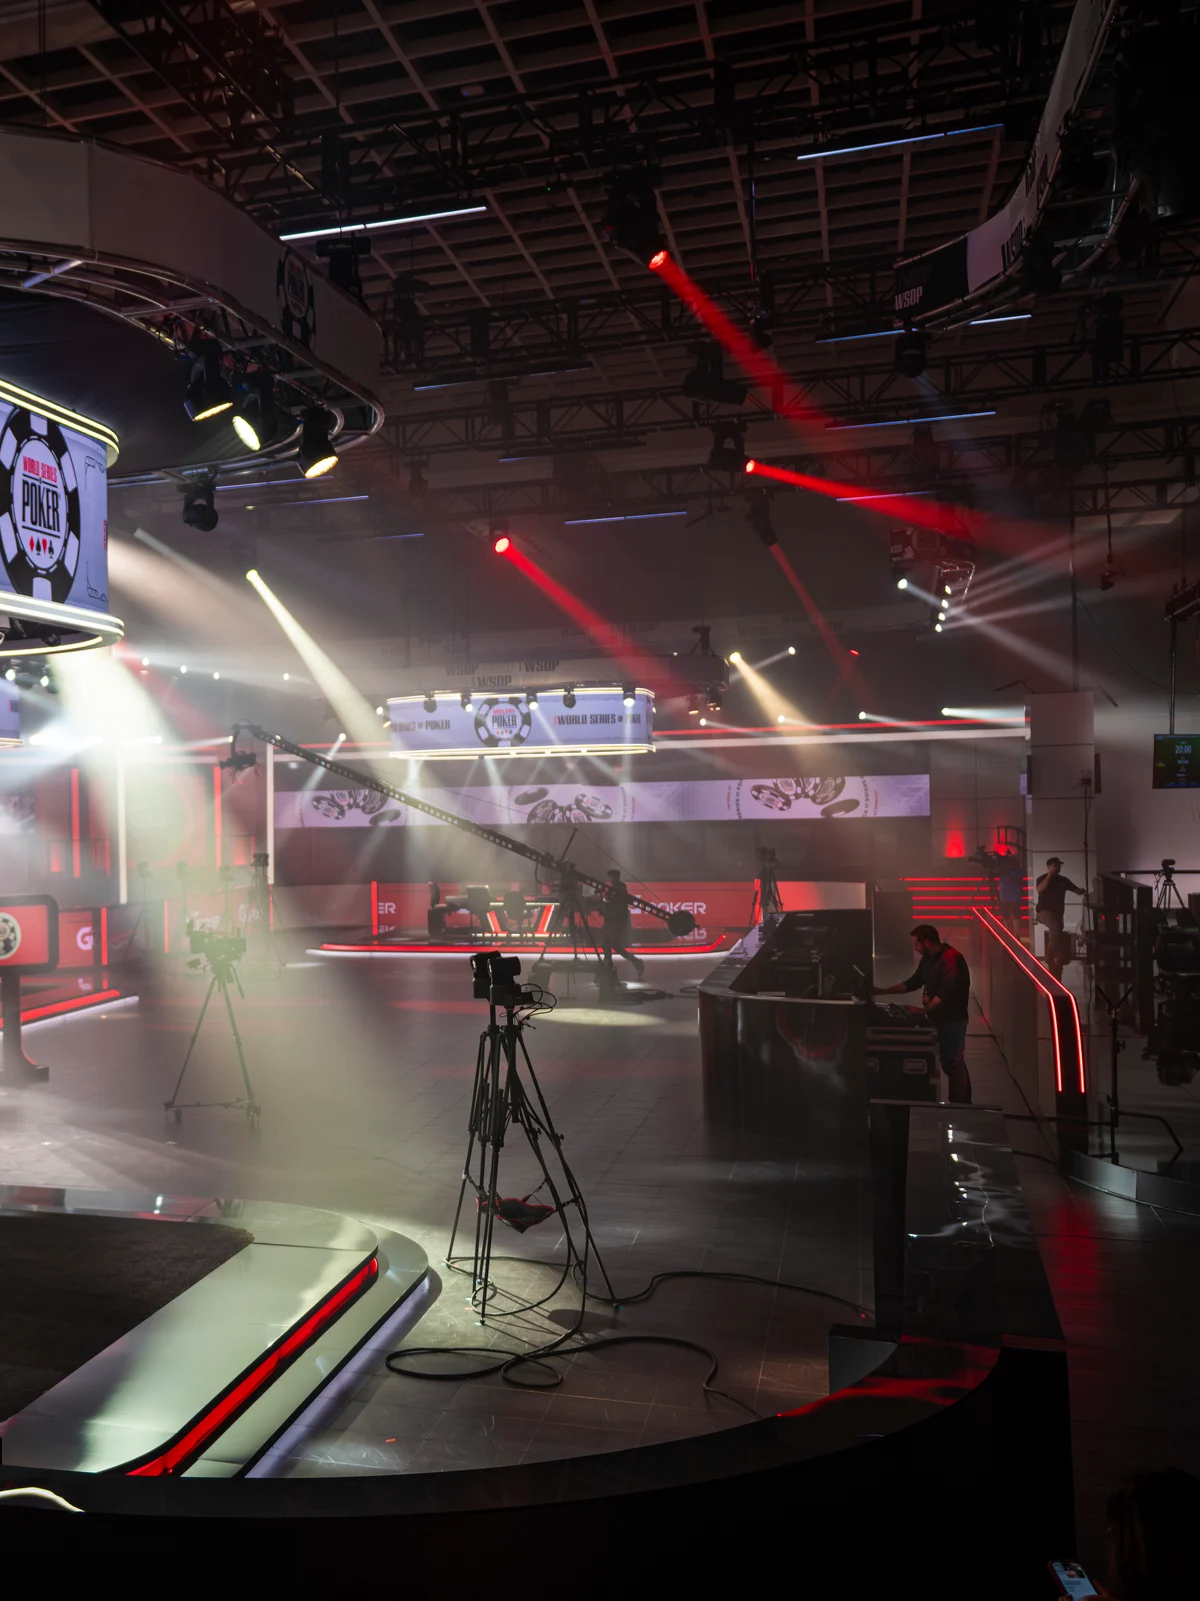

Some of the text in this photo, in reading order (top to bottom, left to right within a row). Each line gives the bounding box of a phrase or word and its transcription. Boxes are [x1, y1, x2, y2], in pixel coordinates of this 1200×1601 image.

[22, 479, 61, 532] POKER
[525, 660, 559, 672] WSOP
[492, 714, 517, 727] POKER
[558, 714, 587, 725] WORLD
